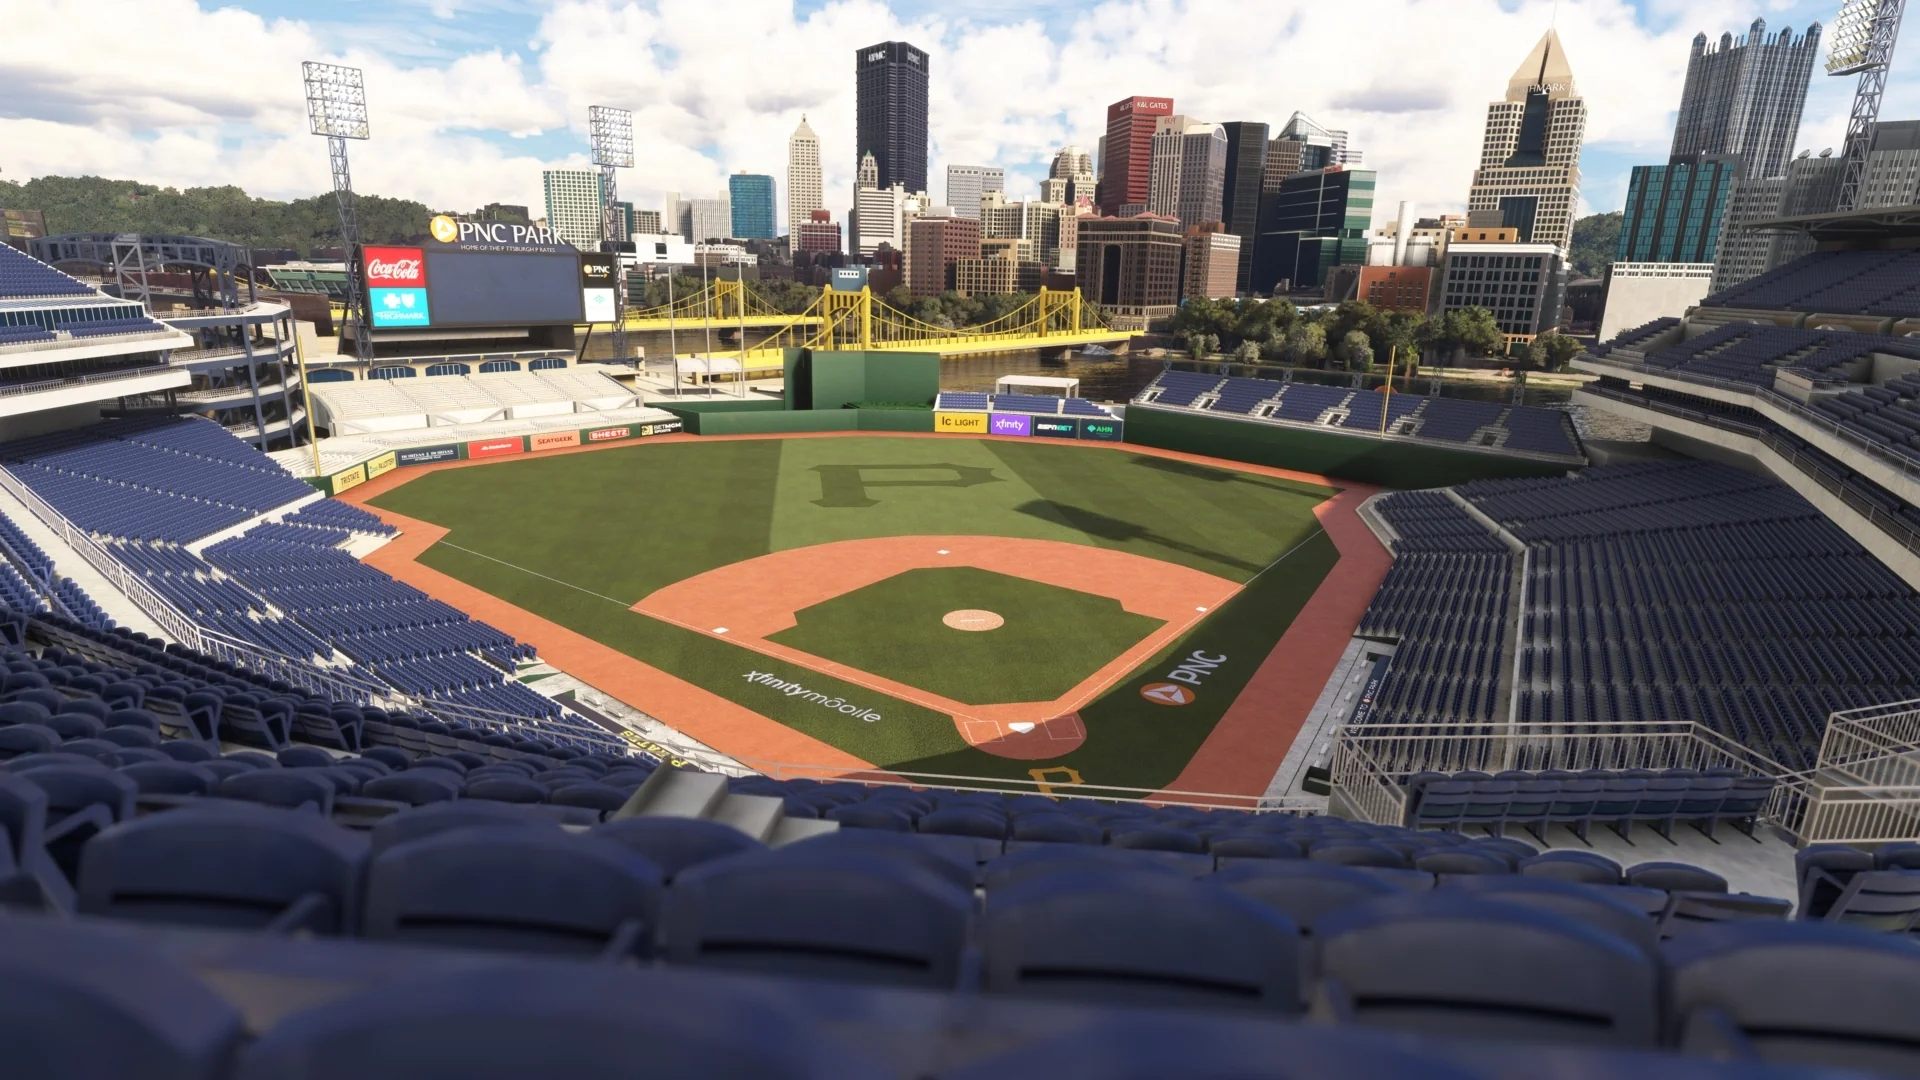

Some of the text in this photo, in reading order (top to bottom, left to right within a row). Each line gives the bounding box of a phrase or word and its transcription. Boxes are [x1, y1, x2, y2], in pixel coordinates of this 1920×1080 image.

[457, 221, 566, 246] PNC PARK
[500, 245, 535, 253] PTTSBURGH
[367, 258, 421, 280] Coca-Cola
[592, 265, 611, 274] PNC
[954, 419, 980, 428] LIGHT
[995, 419, 1024, 431] xfinity
[1096, 425, 1114, 433] AHN
[537, 435, 573, 446] SEATGEEK
[592, 429, 628, 440] SHEETZ
[807, 462, 1007, 508] P
[1167, 650, 1227, 685] PNC
[1350, 710, 1366, 734] WECOME
[1028, 766, 1086, 802] P
